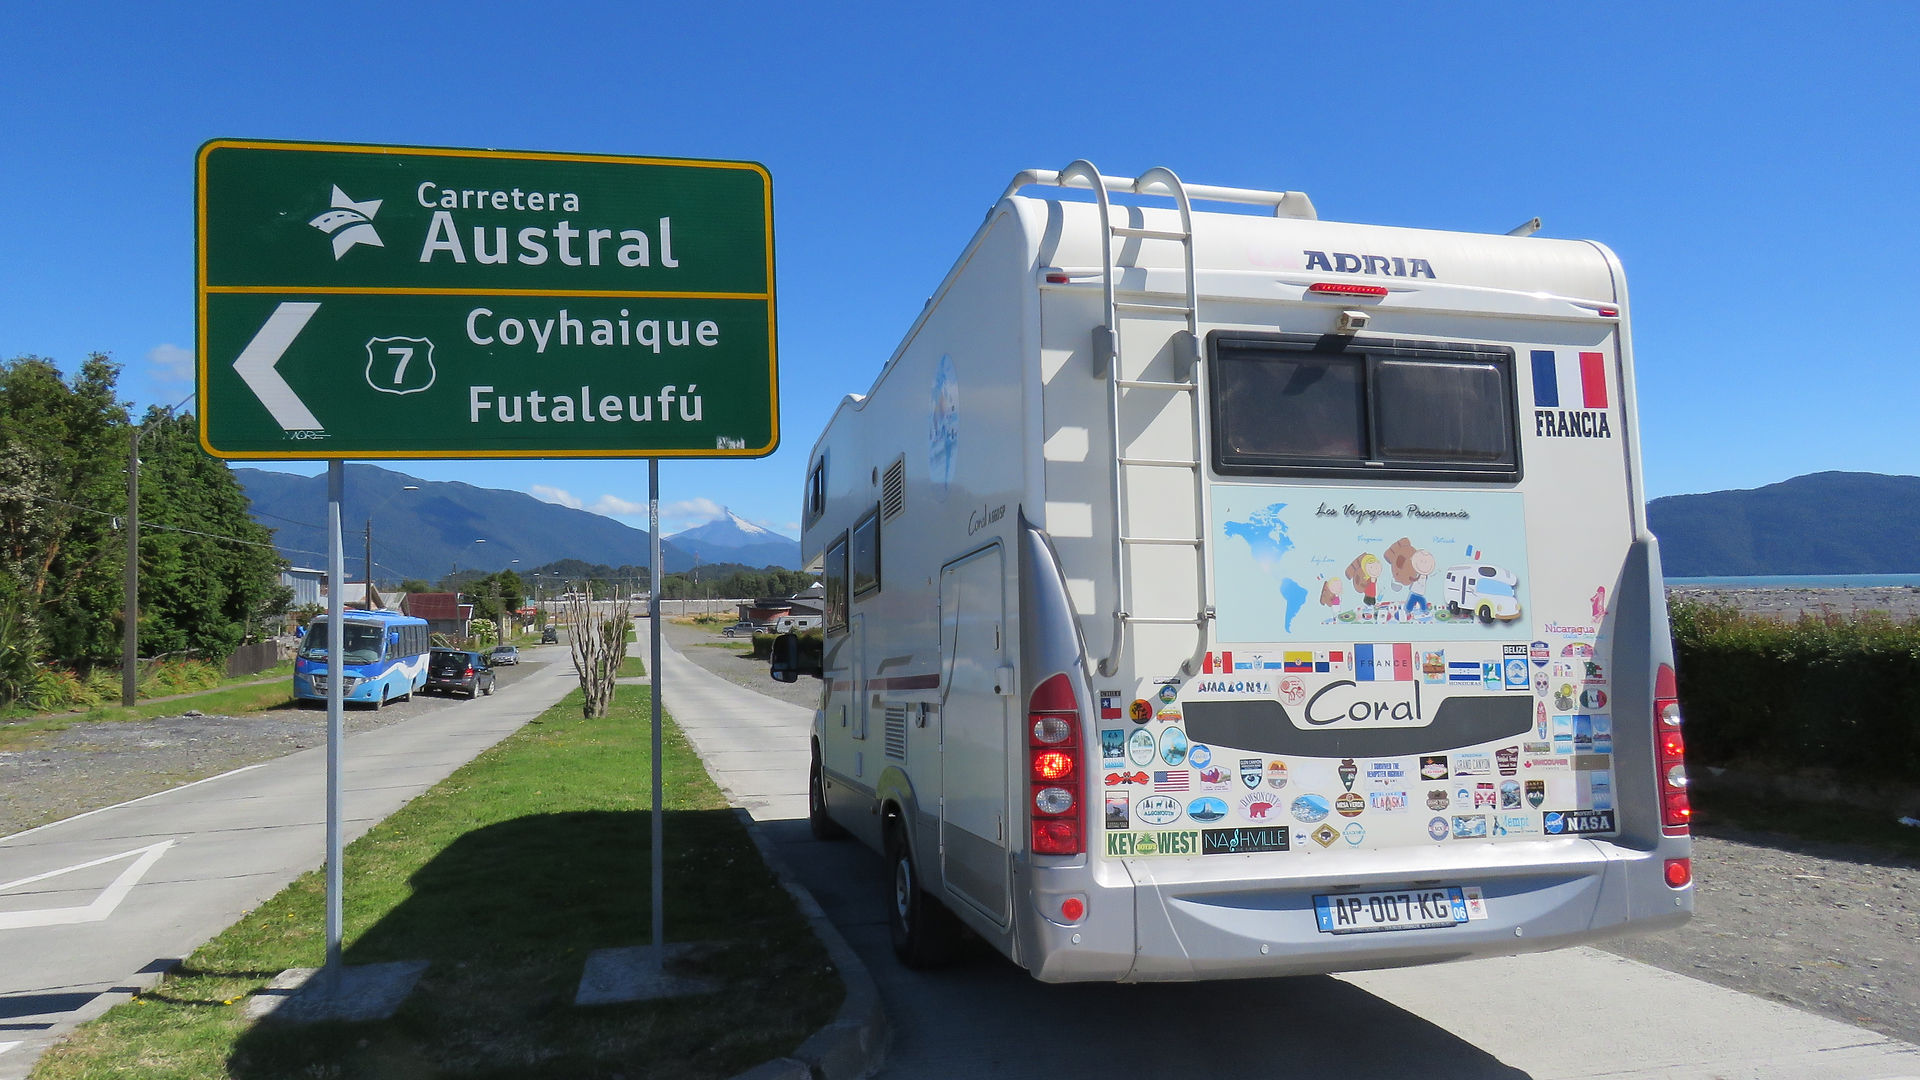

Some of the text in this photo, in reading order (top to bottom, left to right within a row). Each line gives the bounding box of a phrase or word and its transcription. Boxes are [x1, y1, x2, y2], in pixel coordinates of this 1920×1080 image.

[416, 181, 580, 213] Carretera
[419, 209, 680, 268] Austral
[1303, 250, 1437, 279] ADRIA
[465, 307, 720, 354] Coyhaique
[386, 347, 415, 384] 7
[469, 382, 704, 423] Futaleufú
[1533, 410, 1612, 439] FRANCIA
[1315, 502, 1337, 517] Les
[1343, 503, 1402, 525] Voyageurs
[1544, 623, 1596, 636] Nicaragua
[1504, 646, 1527, 654] BELIZE
[1360, 659, 1408, 668] FRANCE
[1304, 679, 1422, 726] Coral
[1566, 816, 1610, 832] NASA
[1107, 831, 1199, 855] KEY WEST
[1204, 828, 1286, 852] NASHVILLE
[1322, 917, 1328, 925] F
[1335, 892, 1449, 926] AP-007-KG
[1453, 906, 1467, 919] 06
